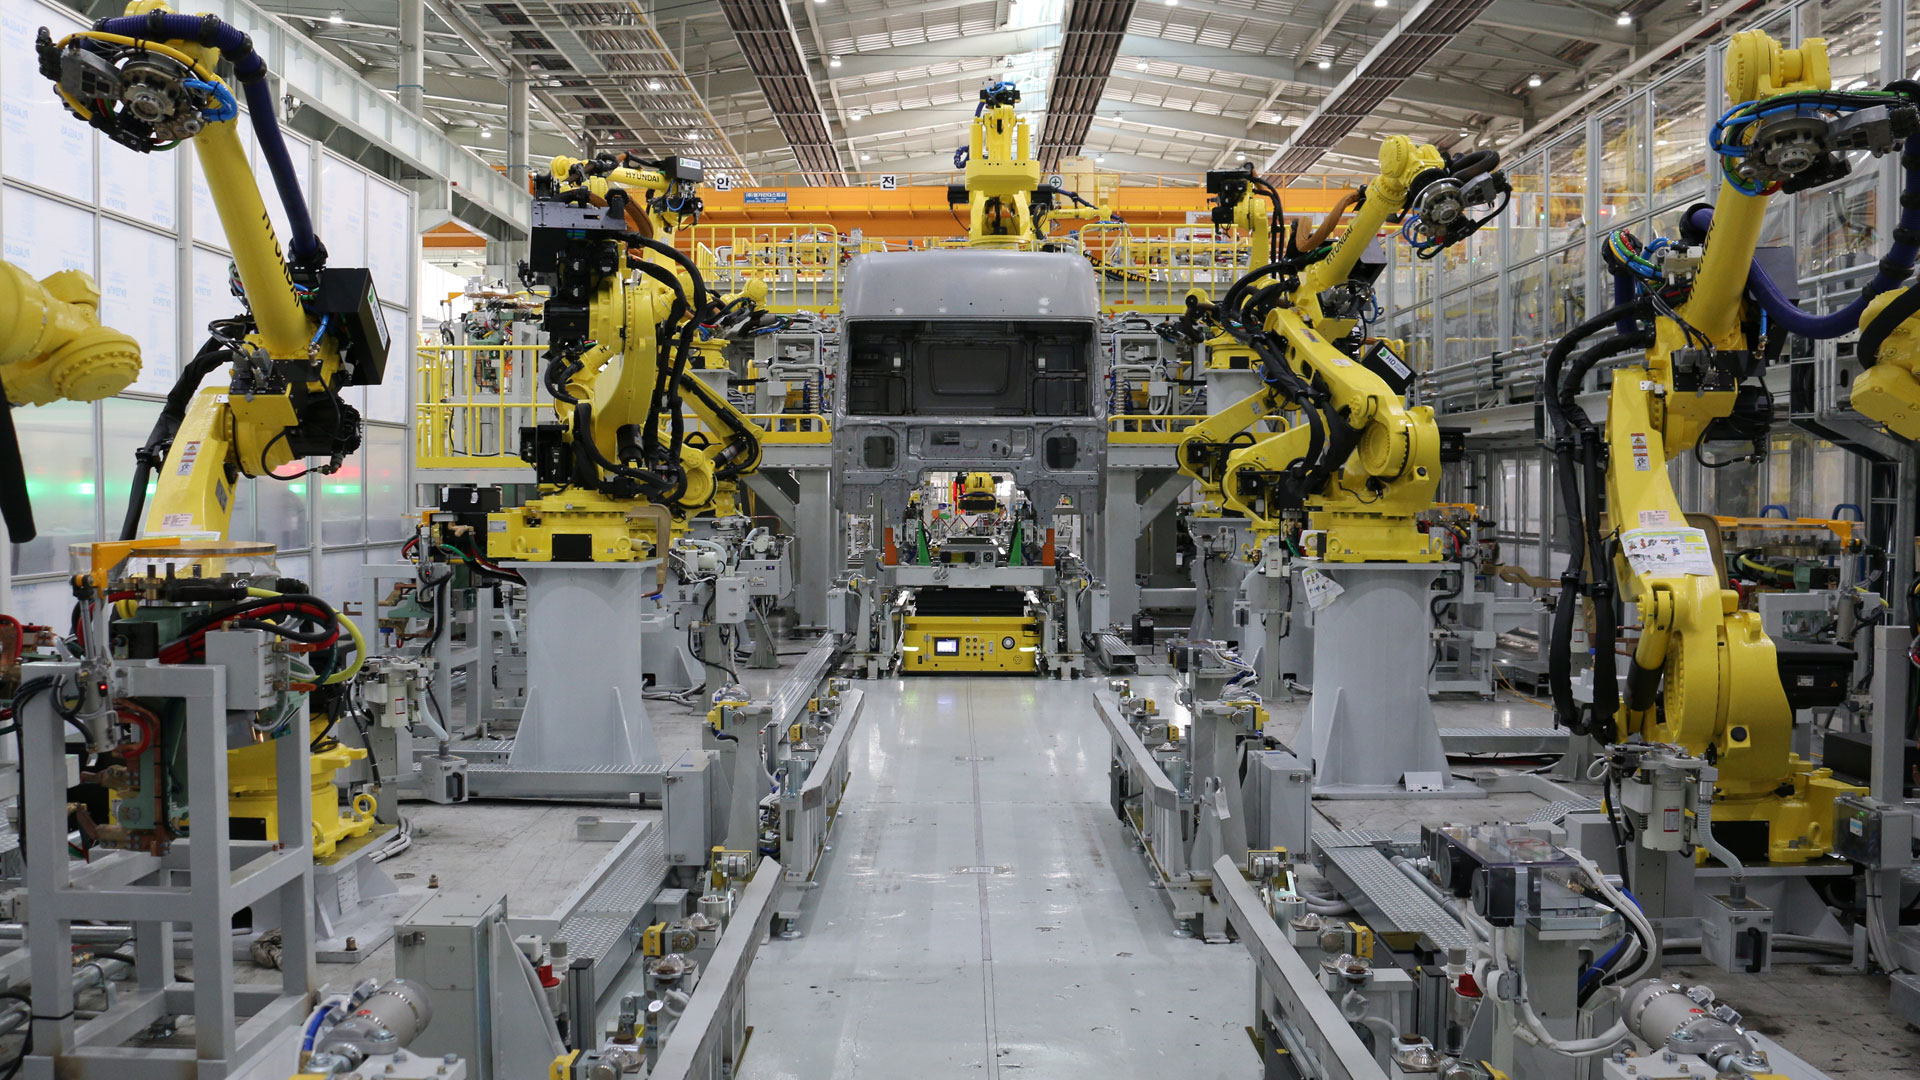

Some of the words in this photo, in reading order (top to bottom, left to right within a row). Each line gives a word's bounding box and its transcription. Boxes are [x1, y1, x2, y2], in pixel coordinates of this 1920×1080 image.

[625, 170, 660, 183] HYUNDAI
[882, 176, 895, 189] 전
[716, 177, 730, 190] 안
[1326, 224, 1353, 265] HYUNDAI
[1386, 355, 1396, 366] HD
